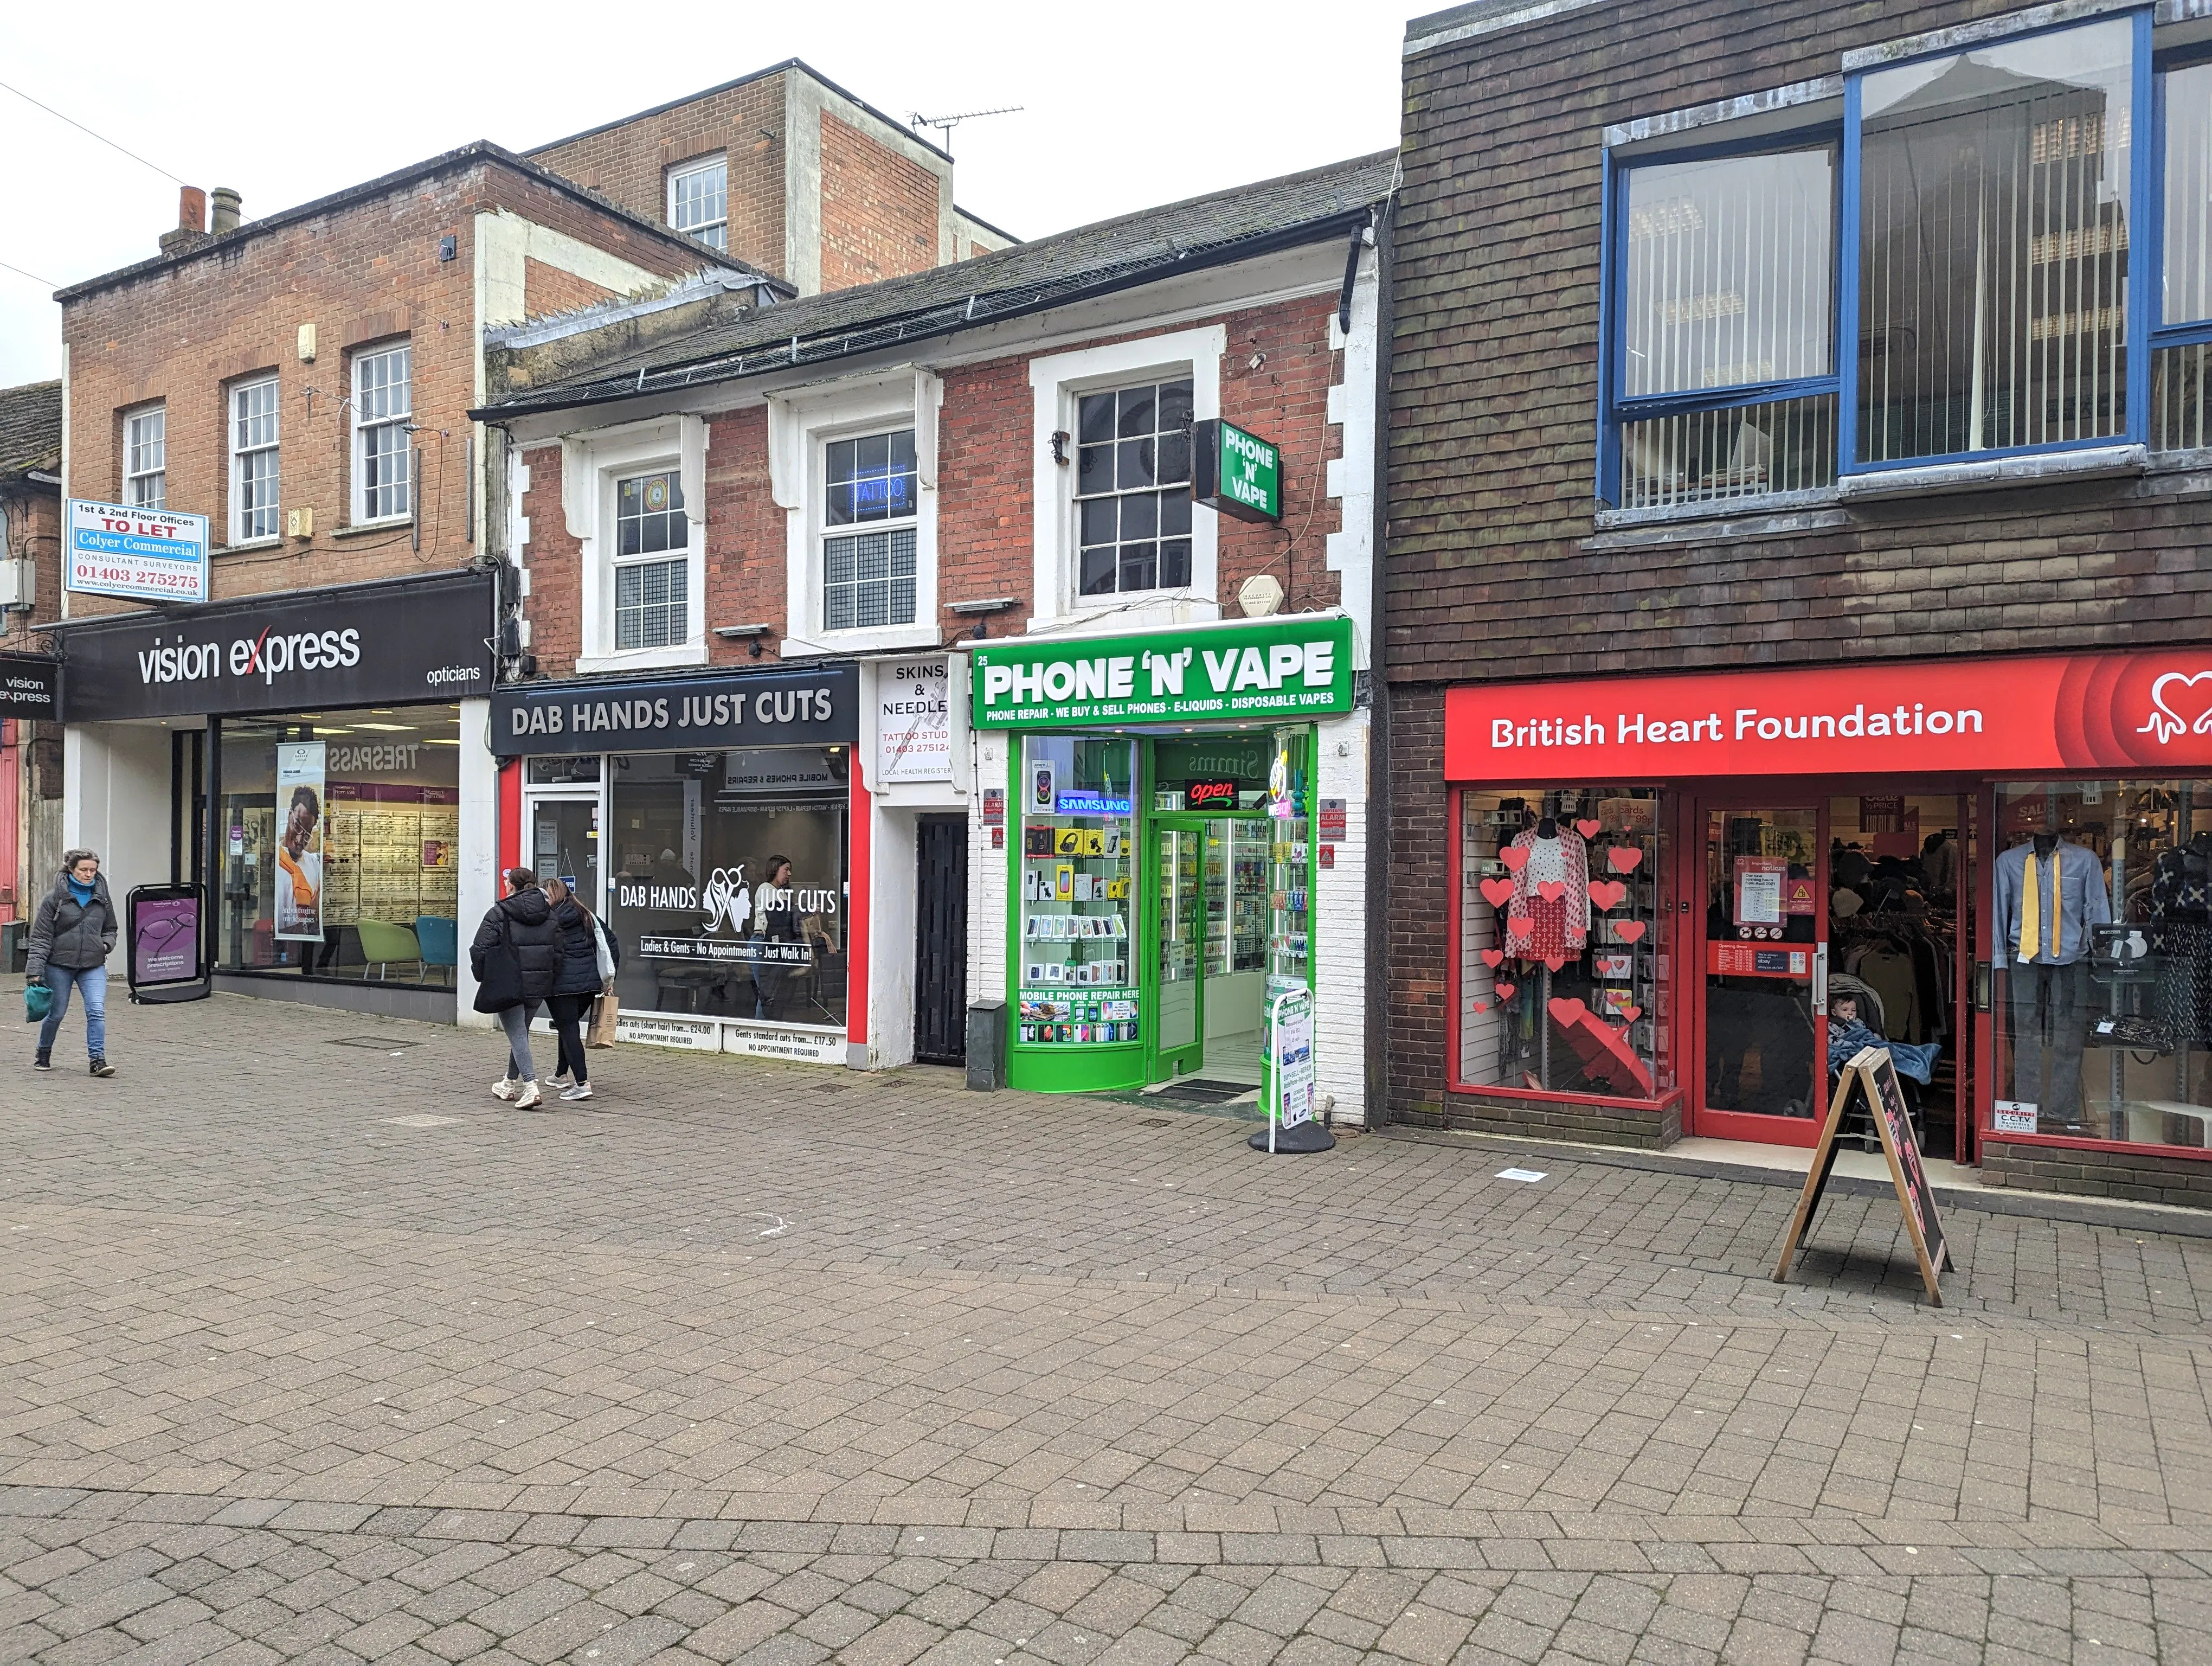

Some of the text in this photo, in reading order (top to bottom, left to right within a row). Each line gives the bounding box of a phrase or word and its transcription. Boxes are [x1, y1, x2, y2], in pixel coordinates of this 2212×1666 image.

[1226, 428, 1273, 469] PHONE
[856, 478, 903, 502] TATTOO
[1232, 476, 1267, 509] VAPE
[78, 504, 94, 514] 1st
[110, 508, 128, 517] 2nd
[131, 511, 156, 522] Floor
[160, 515, 195, 526] Offices
[101, 518, 177, 538] TO LET
[79, 532, 196, 556] Colyer Commercial
[78, 553, 197, 572] CONSULTANT SURVEYORS
[76, 565, 198, 588] 01403 275275
[76, 579, 198, 596] www.colyercommercial.co.uk
[138, 625, 361, 685] vision express
[978, 656, 988, 667] 25
[427, 666, 480, 687] opticians
[896, 665, 944, 680] SKINS
[985, 656, 1135, 705] PHONE
[1201, 641, 1335, 693] VAPE
[5, 676, 44, 690] vision
[915, 684, 925, 695] &
[0, 690, 50, 703] express
[512, 688, 833, 735] DAB HANDS JUST CUTS
[883, 700, 947, 715] NEEDLE
[986, 692, 1334, 721] PHONE REPAIR WE BUY & SELL PHONES E-LIQUIDS DISPOSABLE VAPES
[1491, 703, 1983, 748] British Heart Foundation
[883, 733, 918, 741] TATTOO
[885, 745, 914, 753] 01403
[1191, 783, 1233, 805] open
[1059, 798, 1130, 811] SAMSUNG
[1621, 806, 1644, 814] cards
[2018, 803, 2046, 817] SAL
[1636, 815, 1654, 825] 99p
[620, 885, 835, 913] DAB HANDS JUST CUTS
[641, 940, 812, 960] Ladies & Gents No Appointments Just Walk In!
[147, 960, 184, 970] prescriptions
[1019, 990, 1140, 1001] MOBILE PHONE REPAIR HERE
[1278, 1007, 1294, 1018] PHONE
[1299, 1000, 1310, 1010] VAPE
[616, 1017, 628, 1027] adies
[629, 1019, 640, 1028] cuts
[641, 1019, 657, 1030] (short
[658, 1020, 670, 1031] hair)
[671, 1022, 689, 1033] from...
[690, 1024, 710, 1035] £24.00
[629, 1031, 692, 1045] NO APPOINTMENT REQUIRED
[735, 1028, 837, 1047] Gents standard cuts from... £17.50
[749, 1043, 819, 1058] NO APPOINTMENT REQUIRED
[2001, 1115, 2031, 1123] C.C.T.V.
